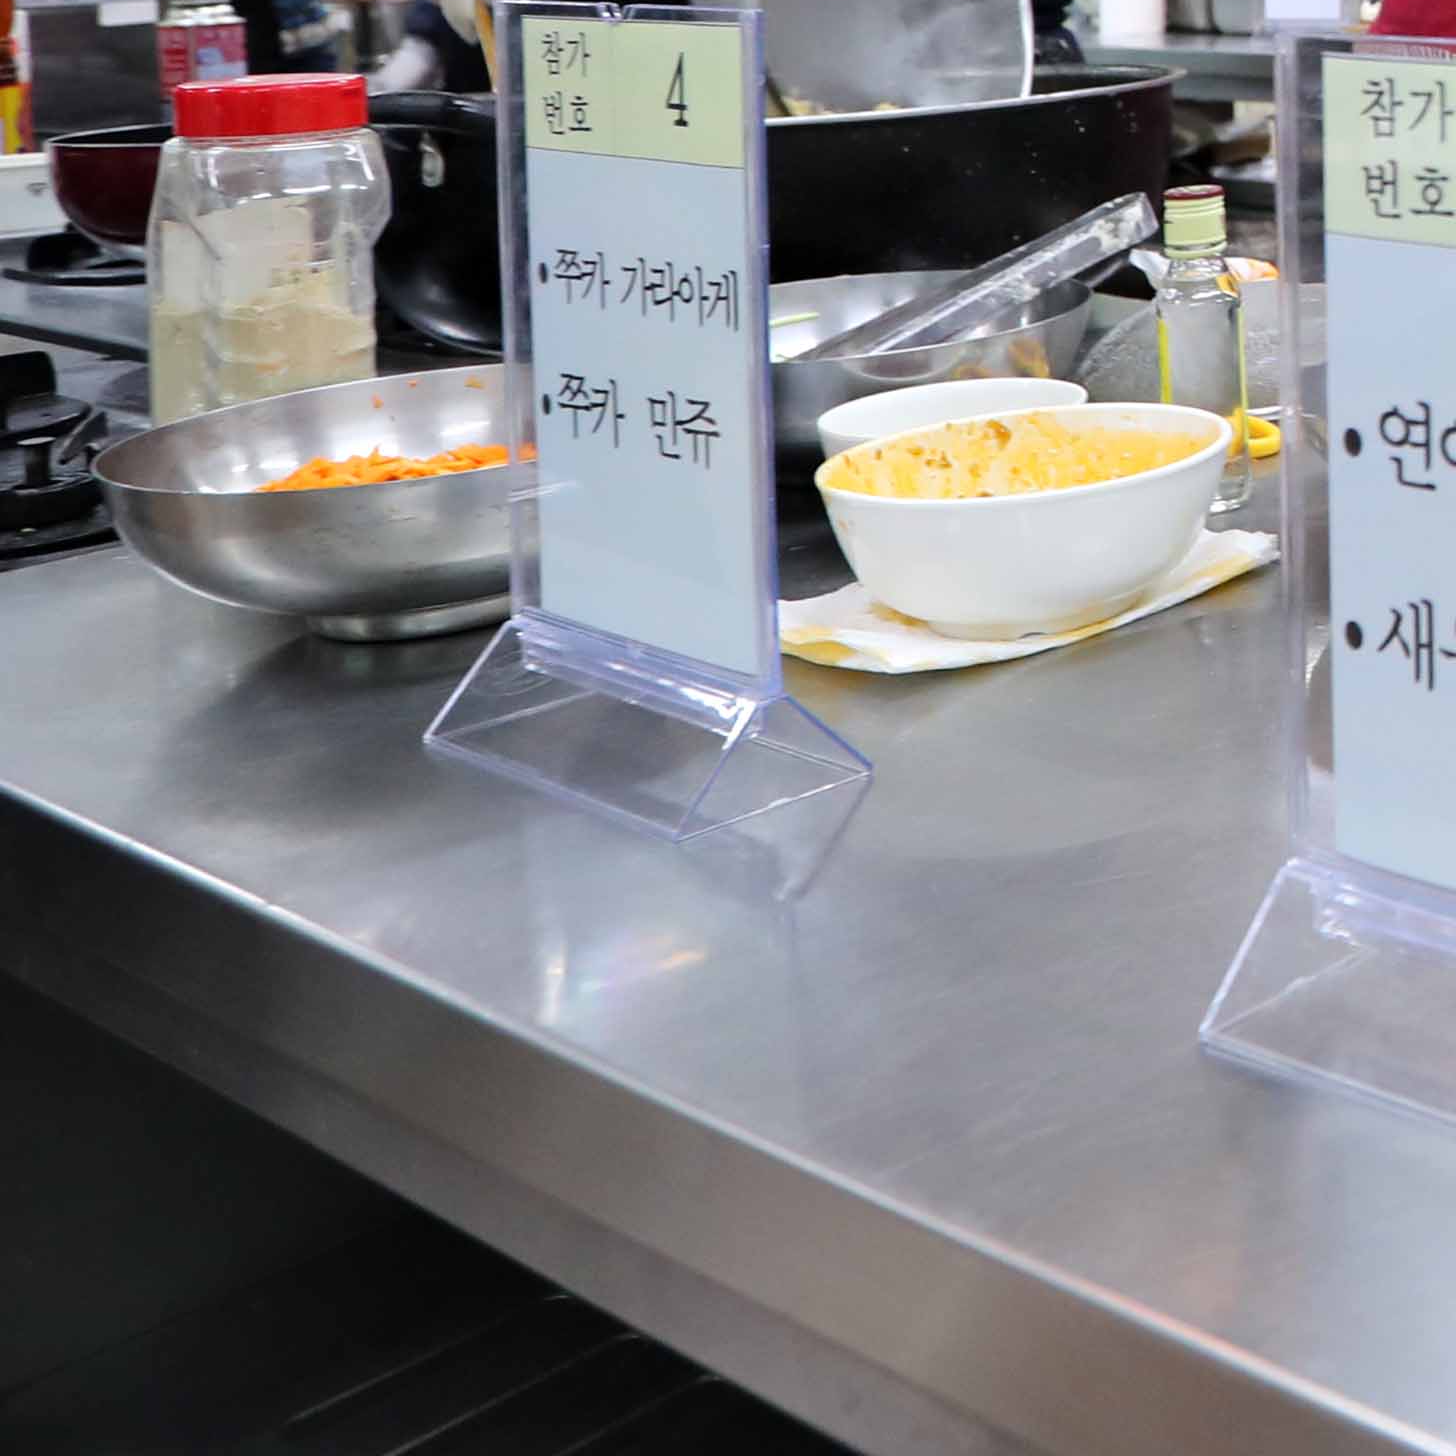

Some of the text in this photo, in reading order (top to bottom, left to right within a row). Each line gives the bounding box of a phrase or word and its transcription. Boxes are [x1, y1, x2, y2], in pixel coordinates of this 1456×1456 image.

[541, 31, 591, 77] 참가
[541, 90, 593, 136] 번호
[665, 51, 689, 128] 4
[1359, 77, 1456, 143] 참가
[1361, 159, 1456, 220] 번호
[620, 257, 739, 332] 가라아게
[646, 390, 721, 470] 만쥬
